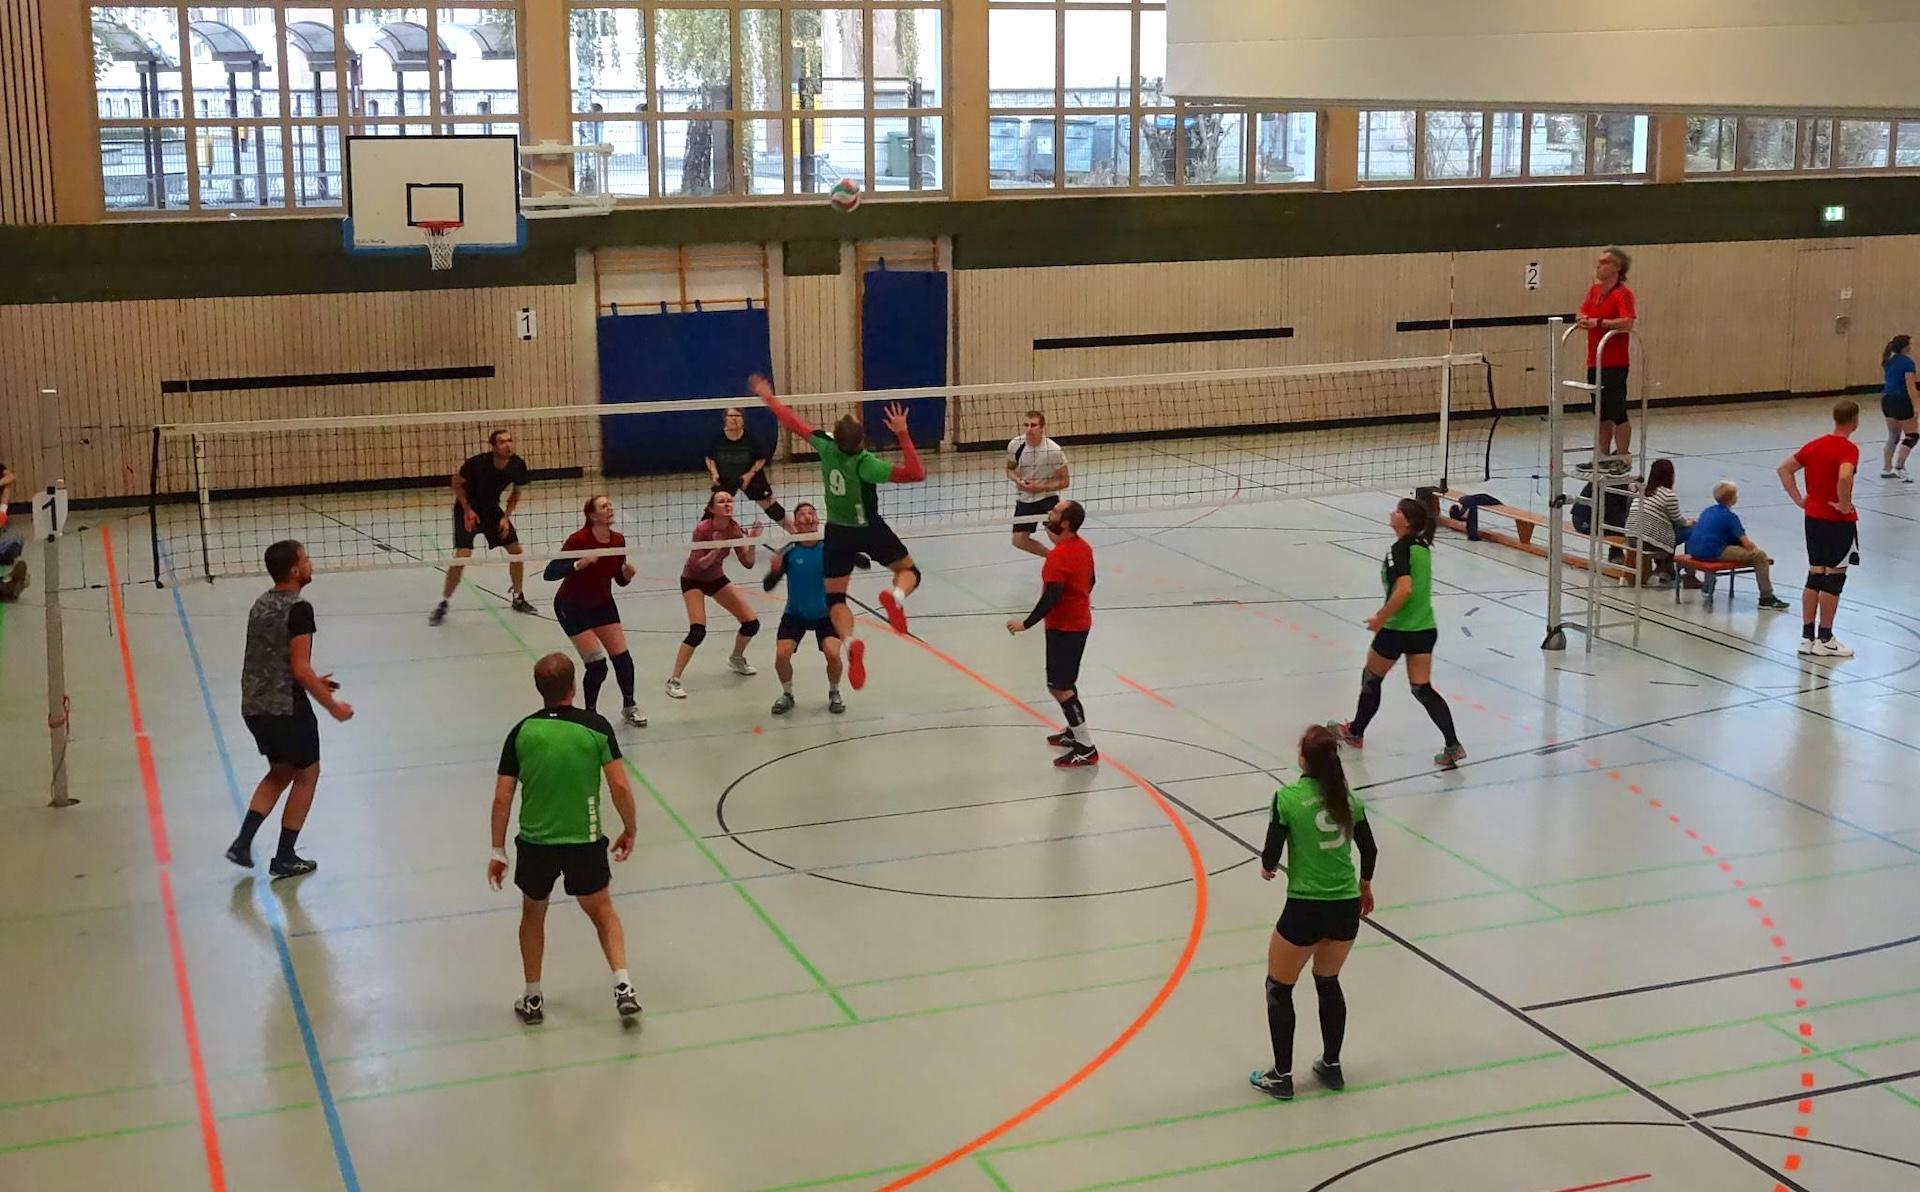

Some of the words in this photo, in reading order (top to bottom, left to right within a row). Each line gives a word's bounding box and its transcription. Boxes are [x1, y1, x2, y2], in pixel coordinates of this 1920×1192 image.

[1528, 268, 1538, 285] 2
[521, 314, 530, 334] 1
[829, 468, 846, 497] 9
[41, 496, 57, 532] 1
